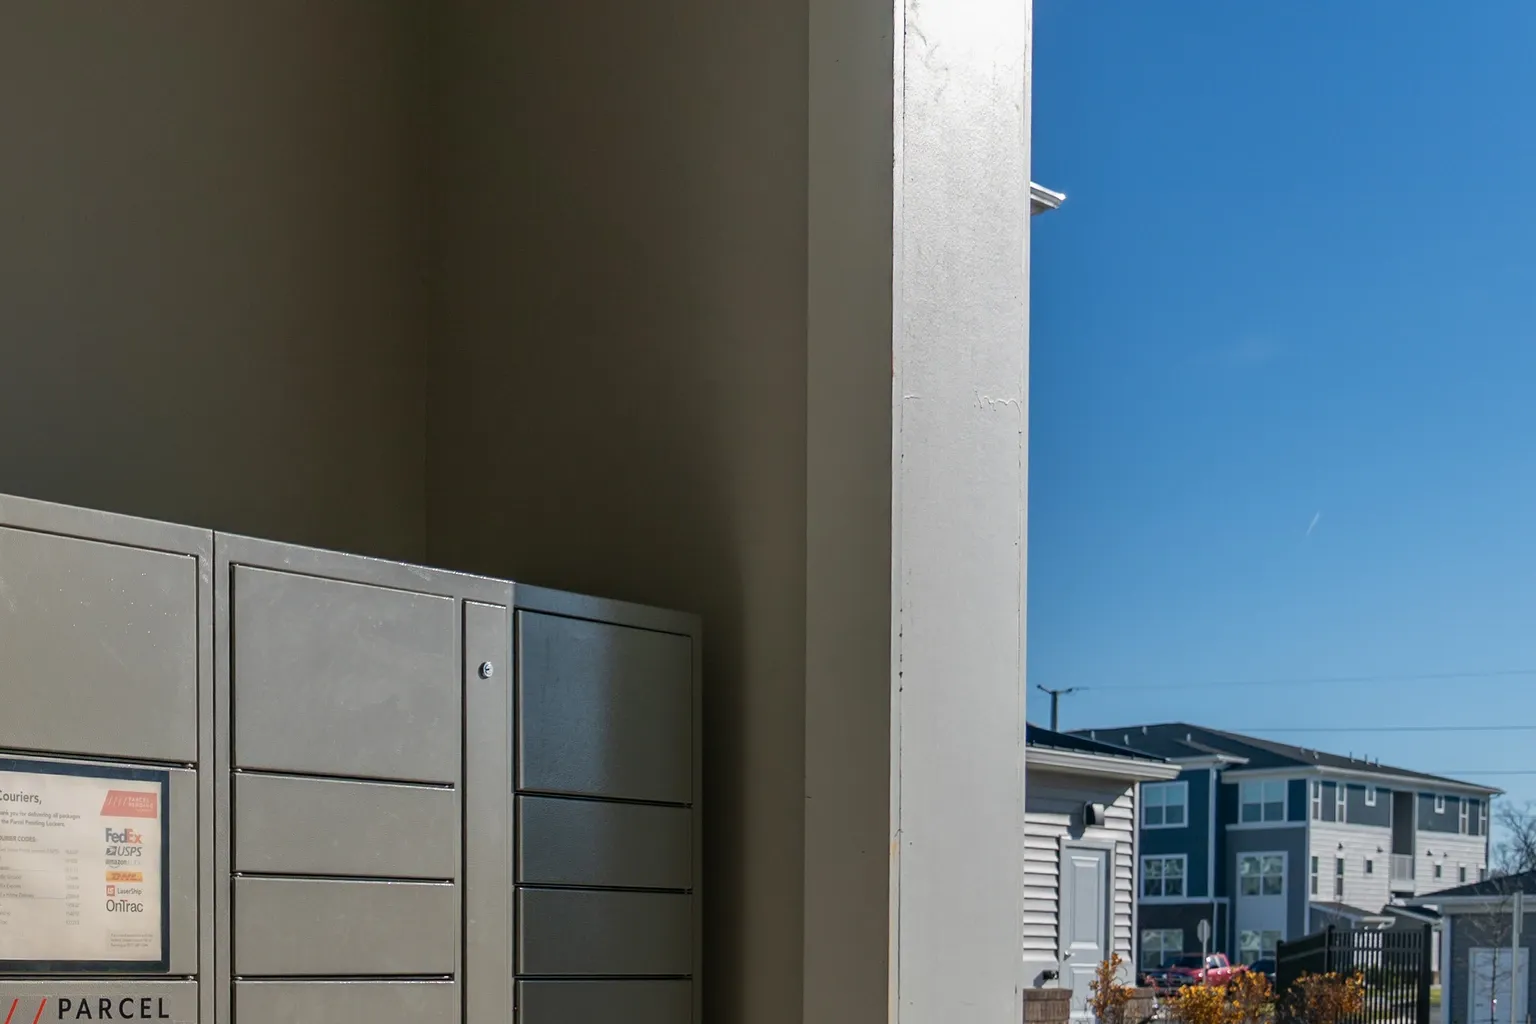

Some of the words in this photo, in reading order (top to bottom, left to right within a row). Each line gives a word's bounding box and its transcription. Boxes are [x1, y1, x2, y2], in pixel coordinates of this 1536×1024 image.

[105, 827, 143, 844] FedEx
[117, 846, 142, 857] USPS
[105, 858, 128, 866] amazon
[117, 888, 142, 896] LaserShip
[106, 899, 144, 913] OnTrac
[58, 997, 170, 1020] PARCEL
